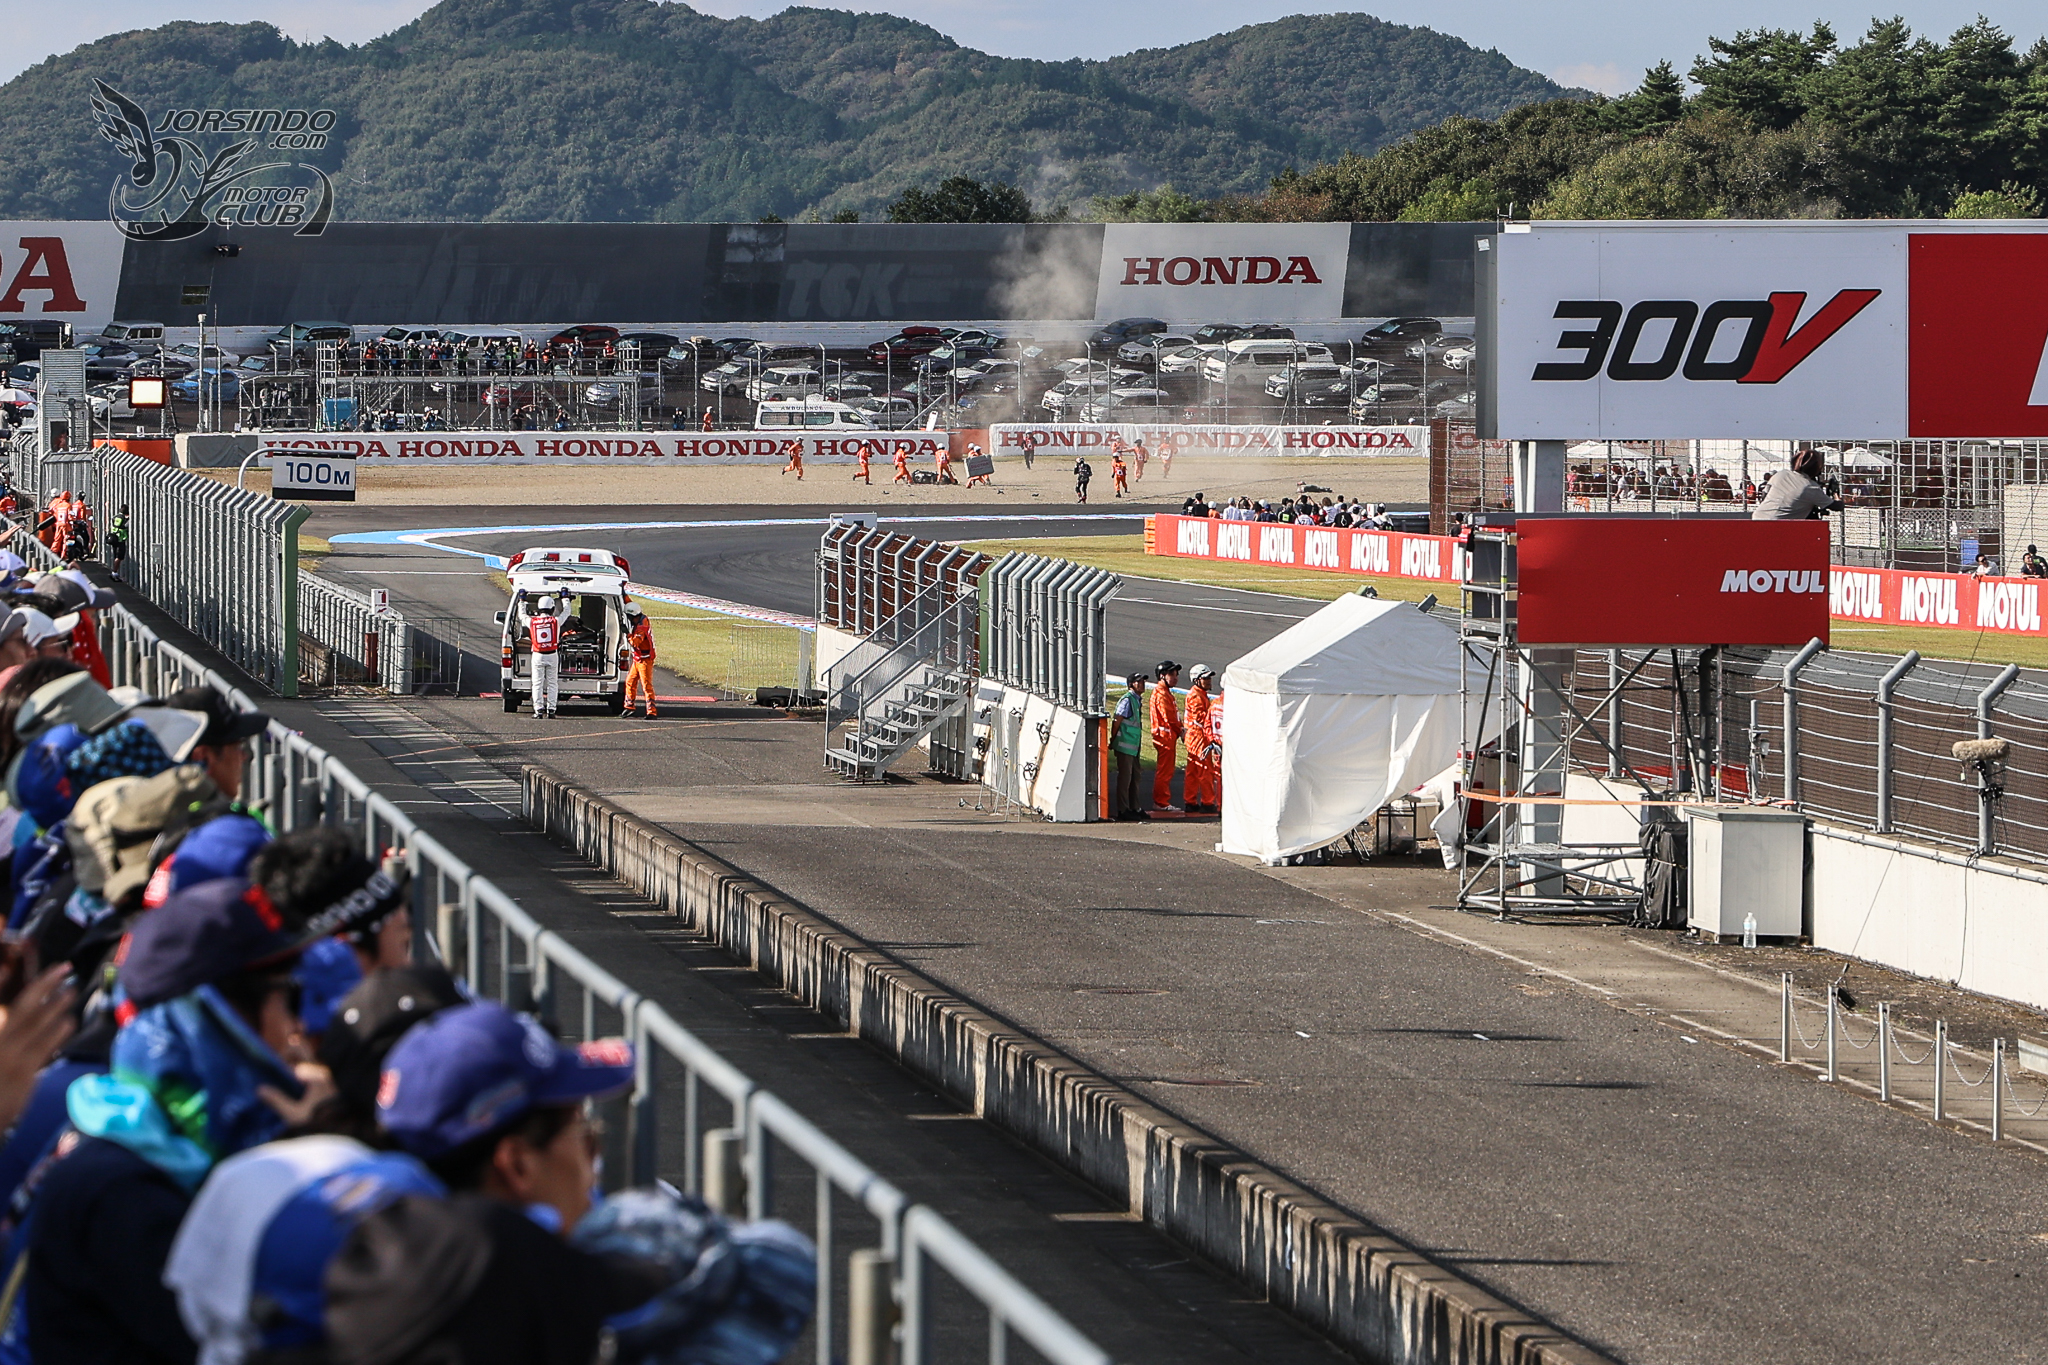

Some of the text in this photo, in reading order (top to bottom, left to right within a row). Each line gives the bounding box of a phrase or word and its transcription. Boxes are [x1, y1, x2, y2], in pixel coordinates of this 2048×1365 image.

[0, 237, 86, 312] A
[1120, 256, 1322, 286] HONDA
[1531, 288, 1882, 384] 300V
[397, 440, 524, 457] HONDA
[535, 439, 664, 456] HONDA
[674, 439, 795, 457] HONDA
[813, 438, 940, 455] HONDA
[1000, 431, 1129, 447] HONDA
[1142, 431, 1270, 448] HONDA
[1284, 431, 1414, 448] HONDA
[285, 461, 350, 485] 100M
[1177, 519, 1210, 556] MOTUL
[1216, 523, 1251, 560] MOTUL
[1259, 527, 1295, 564] MOTUL
[1304, 530, 1340, 568] MOTUL
[1350, 533, 1390, 573] MOTUL
[1400, 538, 1441, 579] MOTUL
[1831, 571, 1883, 619] MOTUL
[1900, 577, 1959, 625] MOTUL
[1976, 582, 2041, 631] MOTUL
[1720, 570, 1825, 593] MOTUL
